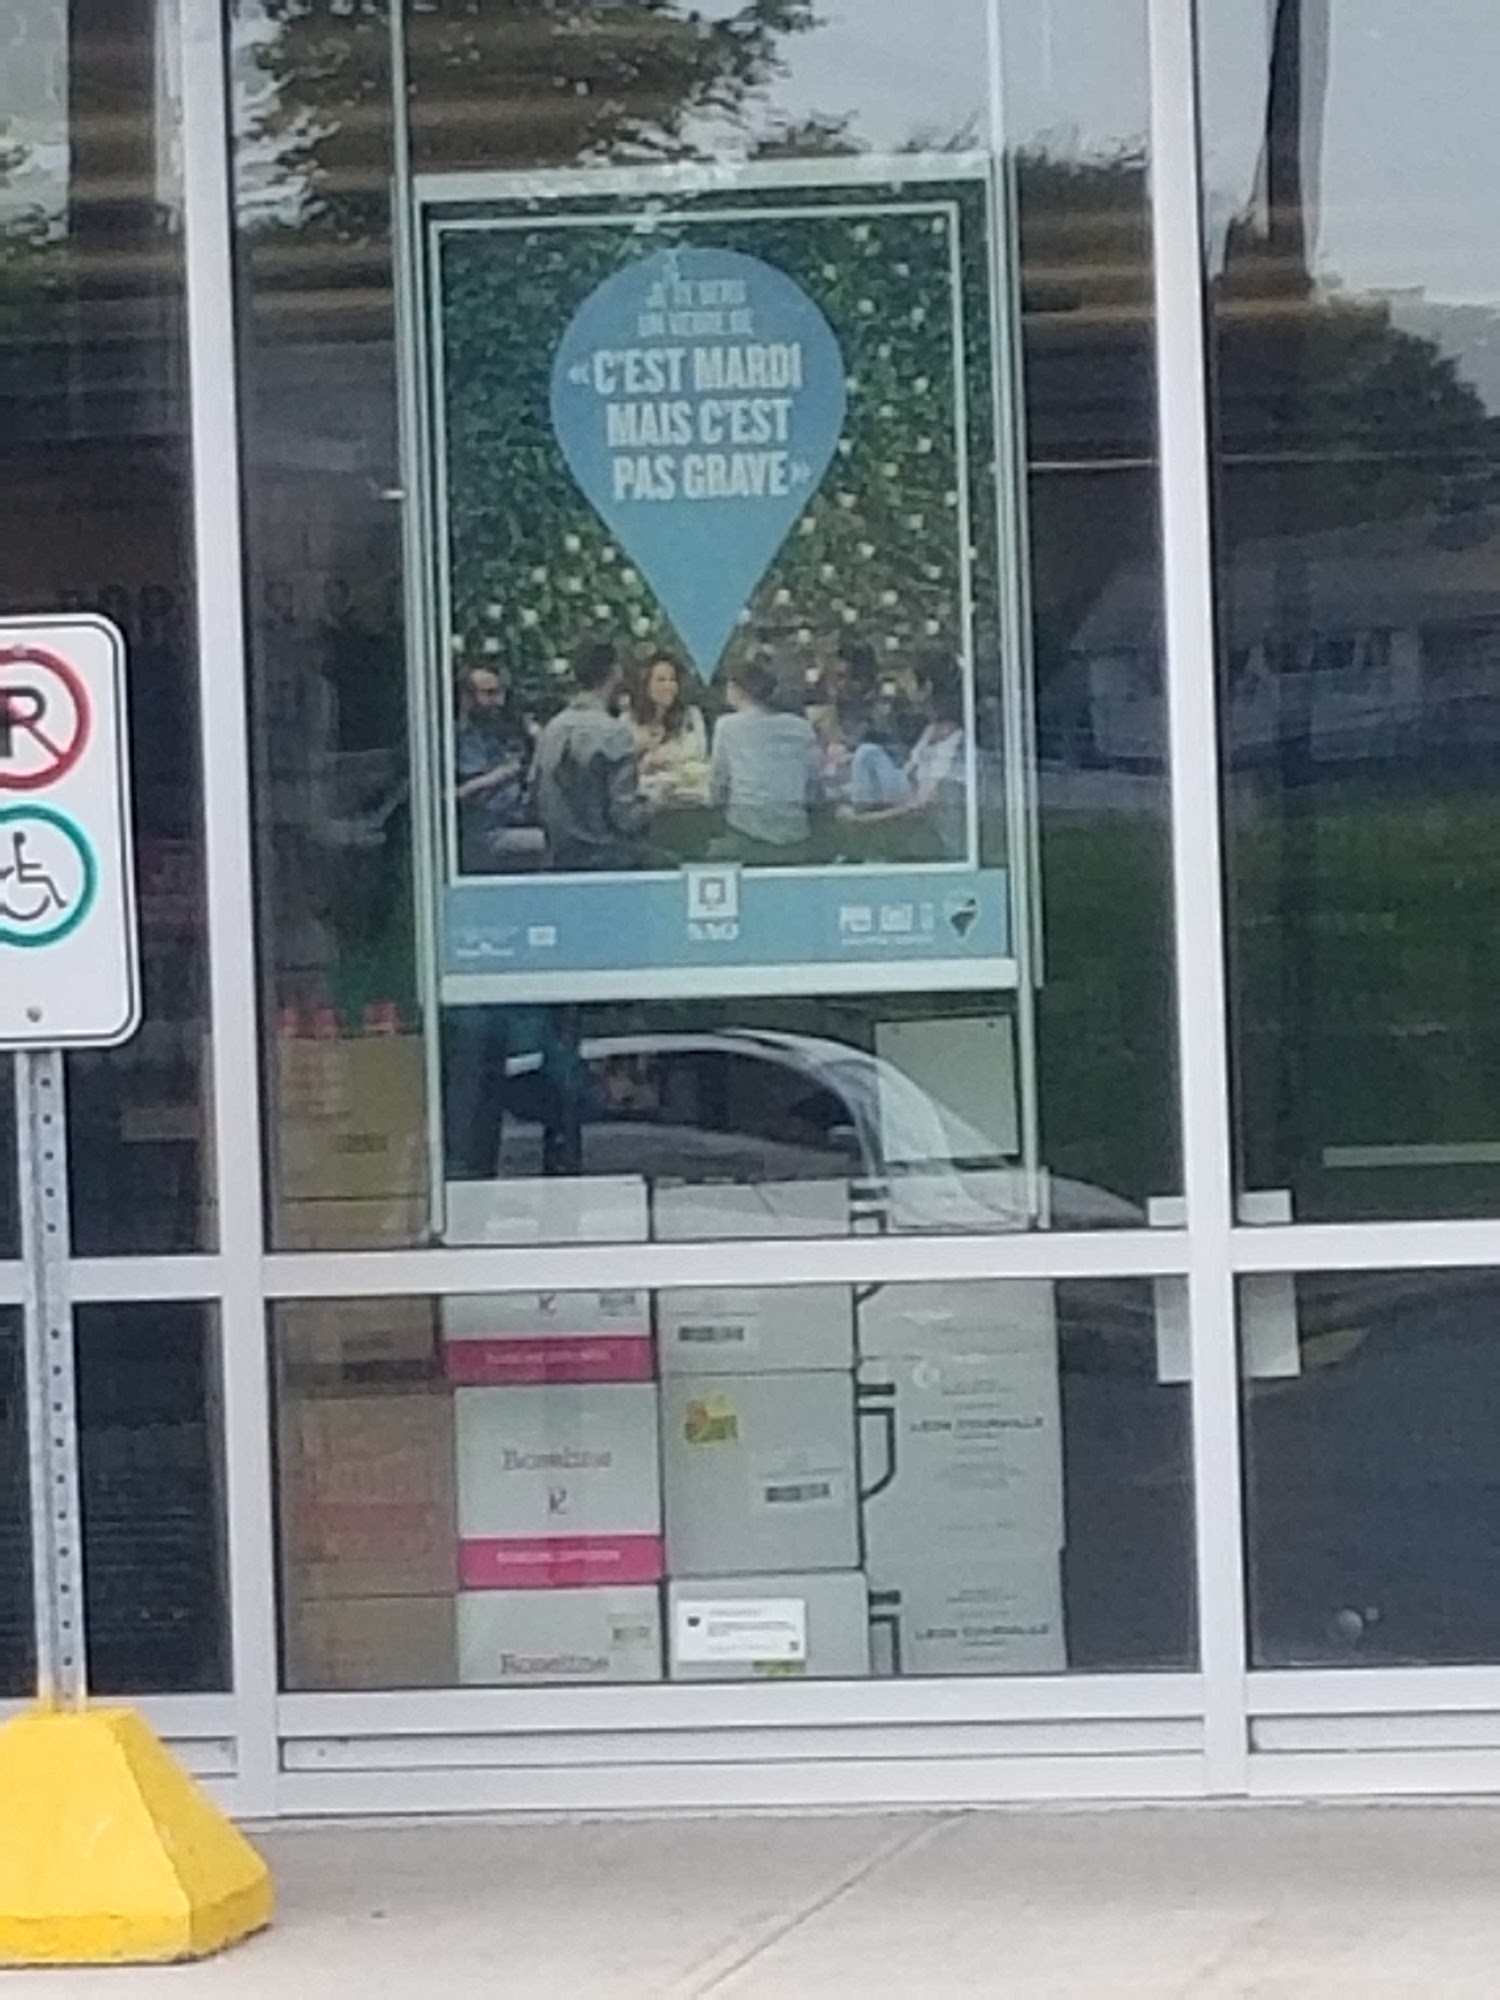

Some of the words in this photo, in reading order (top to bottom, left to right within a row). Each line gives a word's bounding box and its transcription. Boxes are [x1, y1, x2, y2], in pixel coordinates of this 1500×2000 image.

[693, 342, 803, 391] MARDI
[606, 401, 692, 448] MAIS
[700, 398, 793, 446] C'EST
[612, 454, 677, 501] PAS
